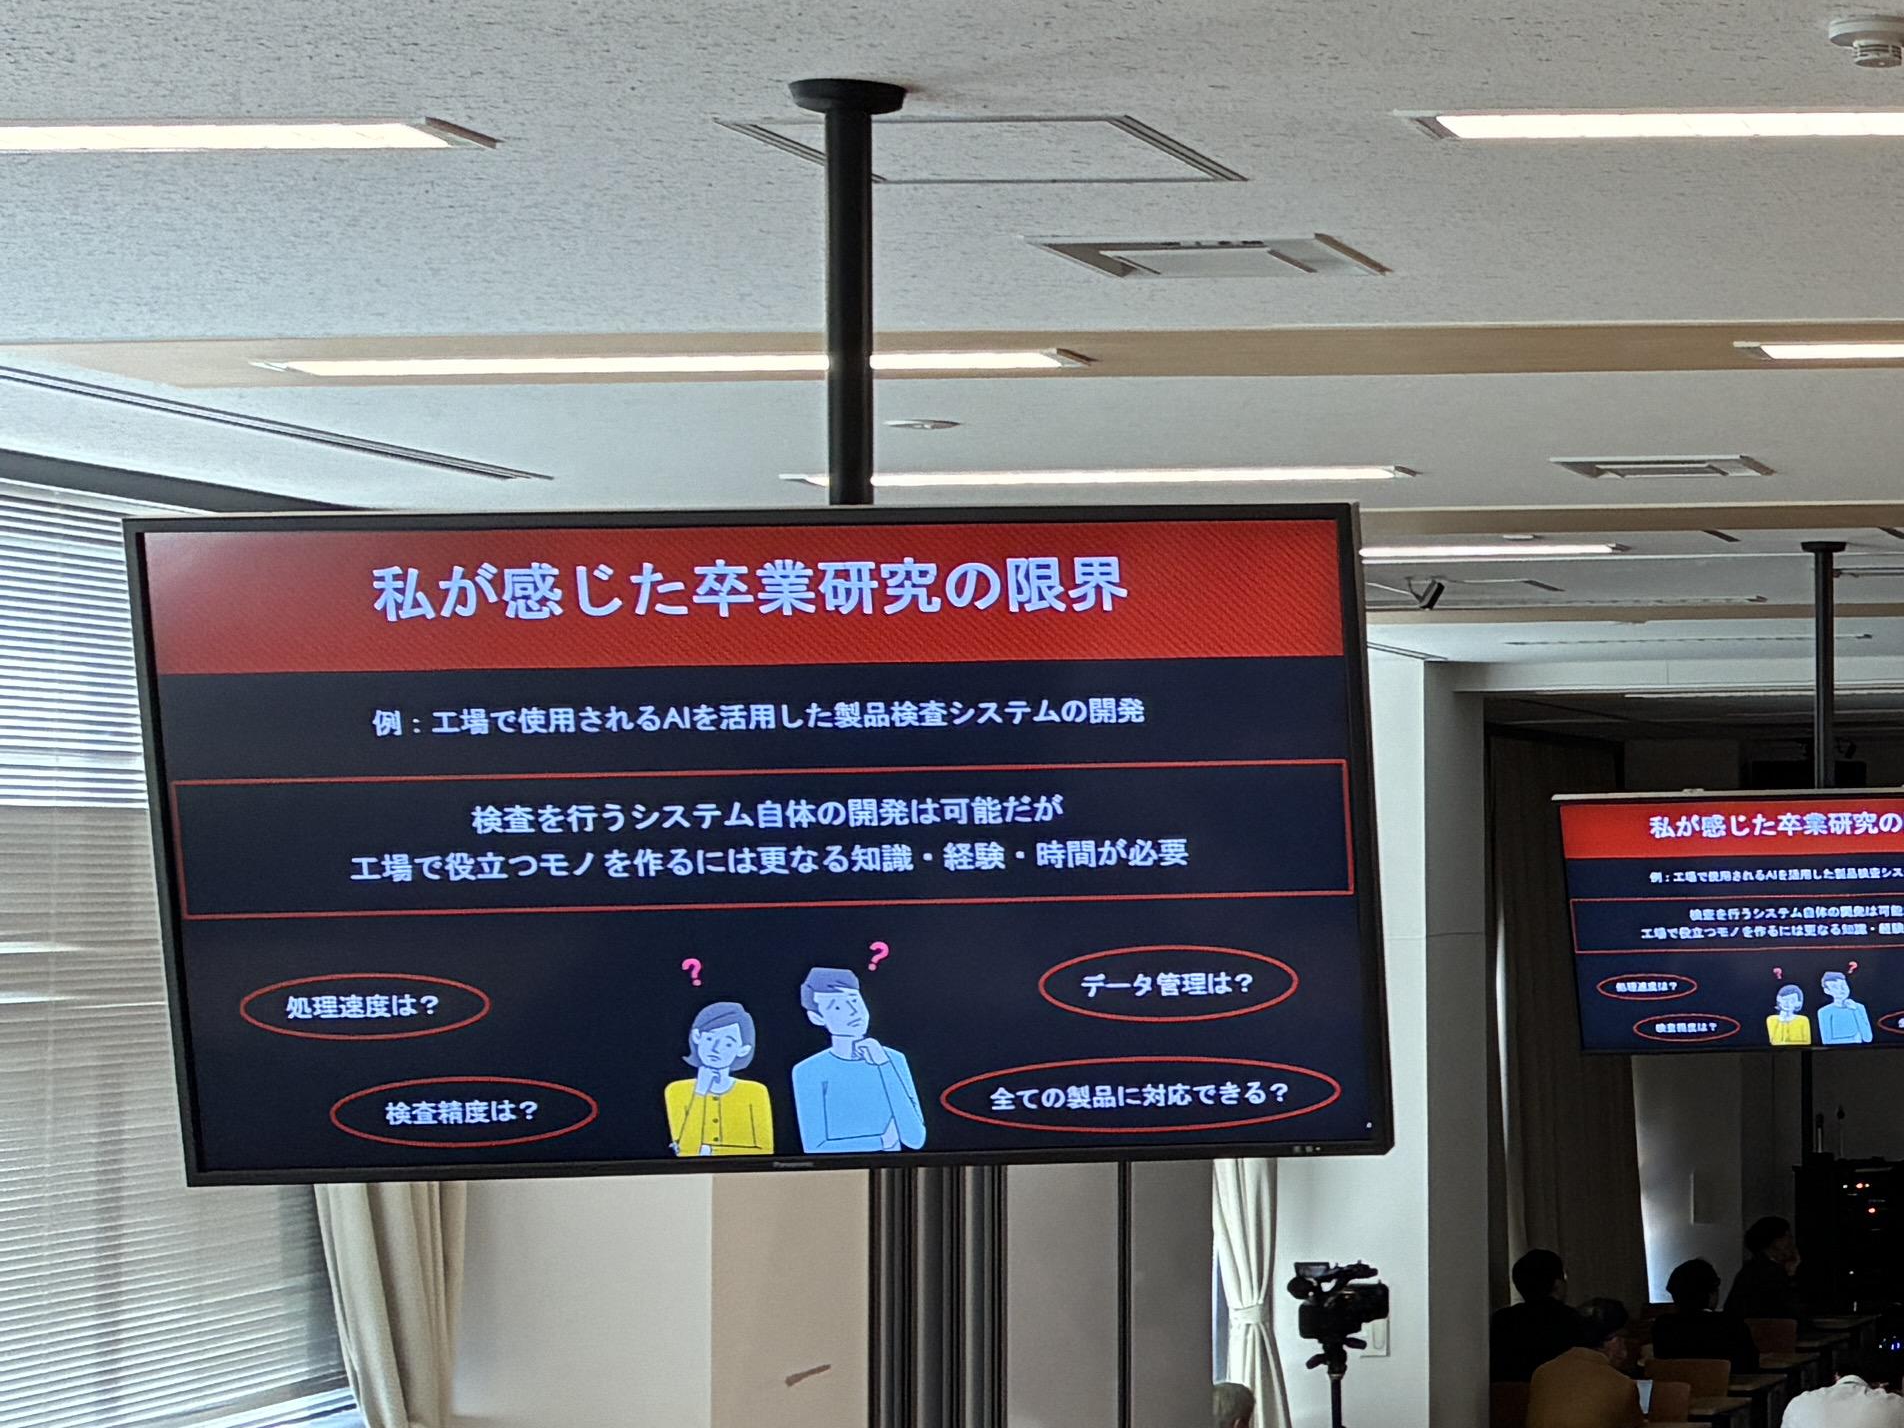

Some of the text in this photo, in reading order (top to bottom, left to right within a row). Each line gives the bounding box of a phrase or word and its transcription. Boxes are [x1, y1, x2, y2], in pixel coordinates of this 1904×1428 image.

[372, 556, 1128, 622] 私が感じた卒業研究の限界
[372, 697, 1145, 737] 例：工場で使用されるAIを活用した製品検査システムの開発
[470, 793, 1064, 835] 検査を行うシステム自体の開発は可能だが
[350, 837, 1189, 883] 工場で役立つモノを作るには更なる知識・経験・時間が必要
[1080, 971, 1253, 998] データ管理は？
[285, 993, 440, 1020] 処理速度は？
[385, 1099, 538, 1126] 検査精度は？
[989, 1081, 1289, 1111] 全ての製品に対応できる？
